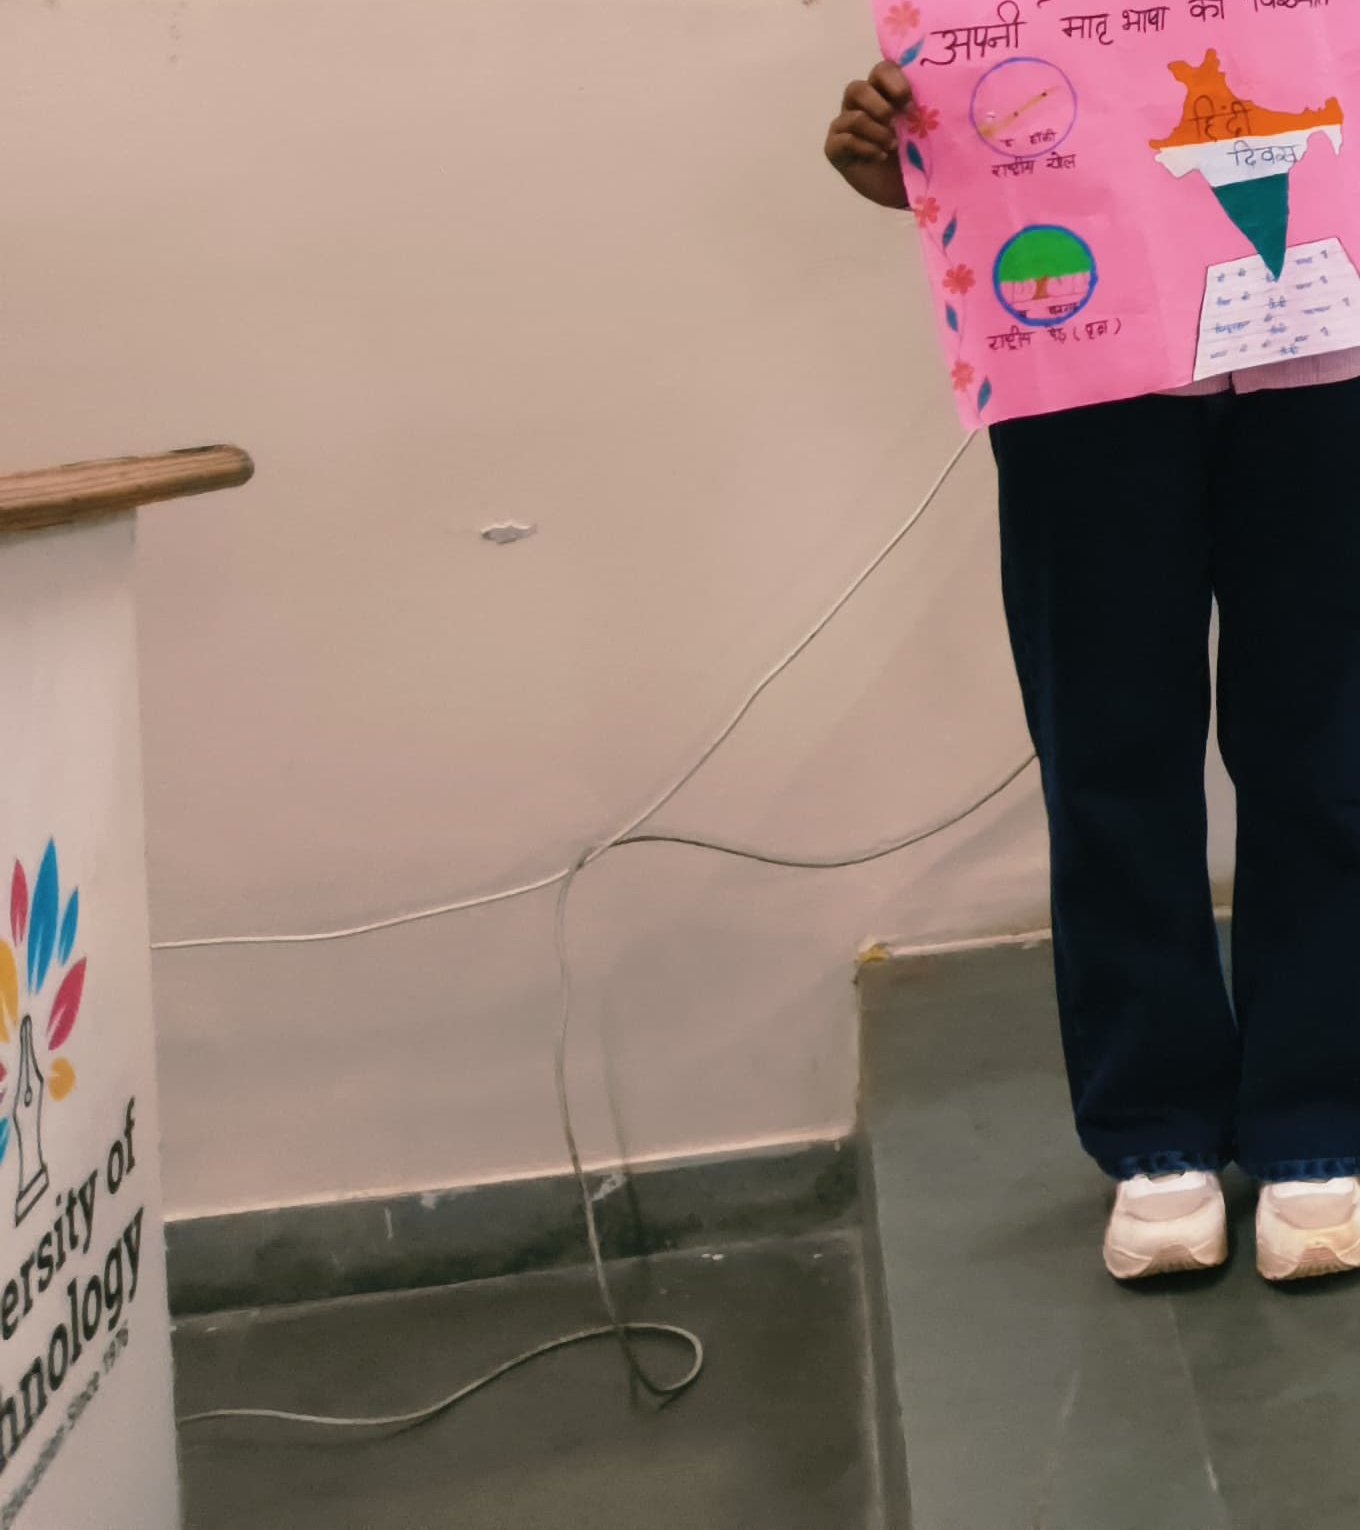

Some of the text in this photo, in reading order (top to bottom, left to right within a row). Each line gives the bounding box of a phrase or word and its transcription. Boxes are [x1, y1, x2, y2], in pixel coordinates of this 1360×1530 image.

[920, 0, 1028, 66] अपनी
[1188, 94, 1254, 142] हिंदी
[1226, 140, 1303, 166] दिवस
[105, 1096, 136, 1194] of
